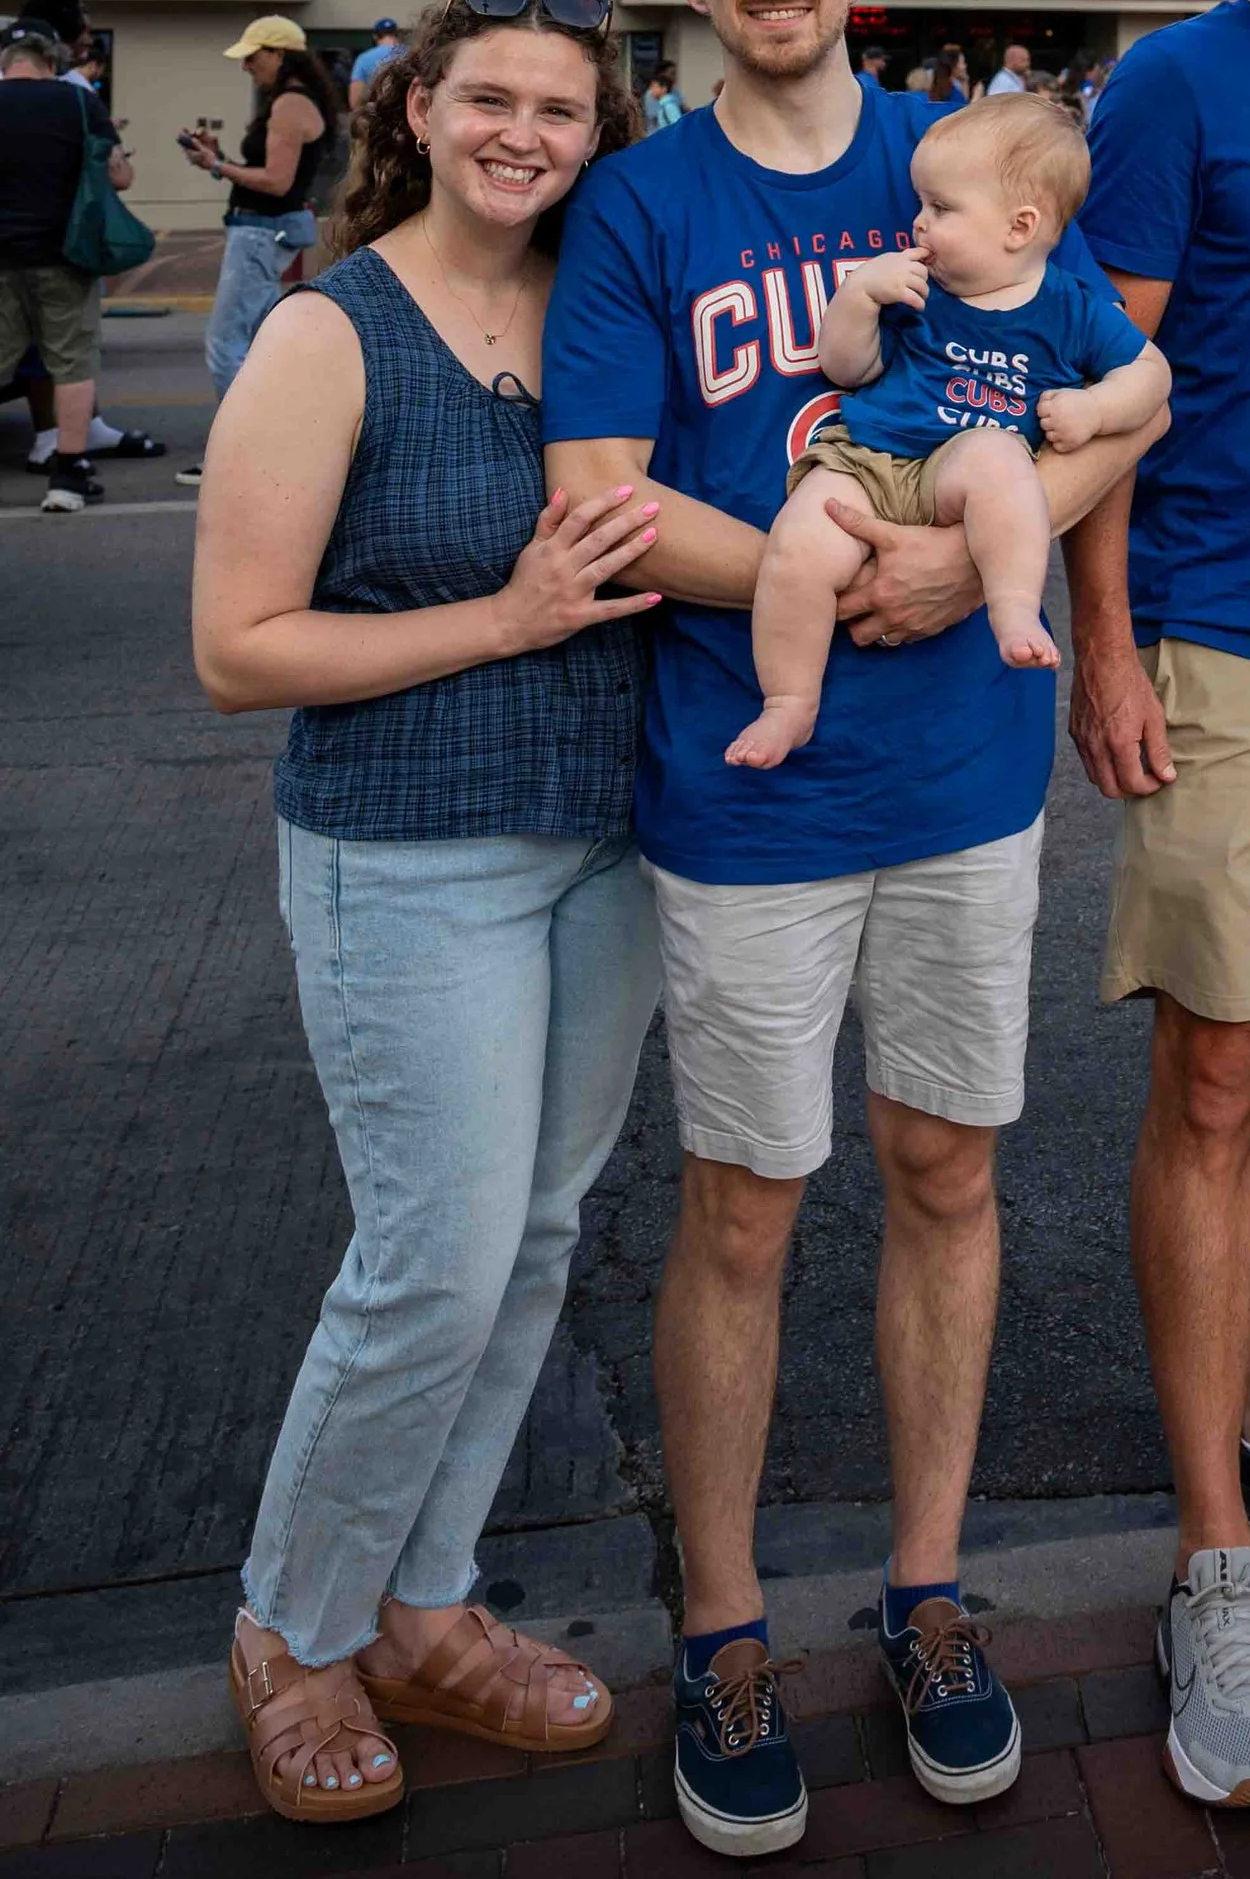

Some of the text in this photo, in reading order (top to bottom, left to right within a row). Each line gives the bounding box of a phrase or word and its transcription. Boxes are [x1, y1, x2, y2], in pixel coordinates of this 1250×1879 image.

[740, 229, 910, 269] CHICAGO
[691, 257, 878, 409] CU
[946, 377, 1027, 416] CUBS
[952, 363, 1027, 396] BS
[1219, 1550, 1229, 1591] AI
